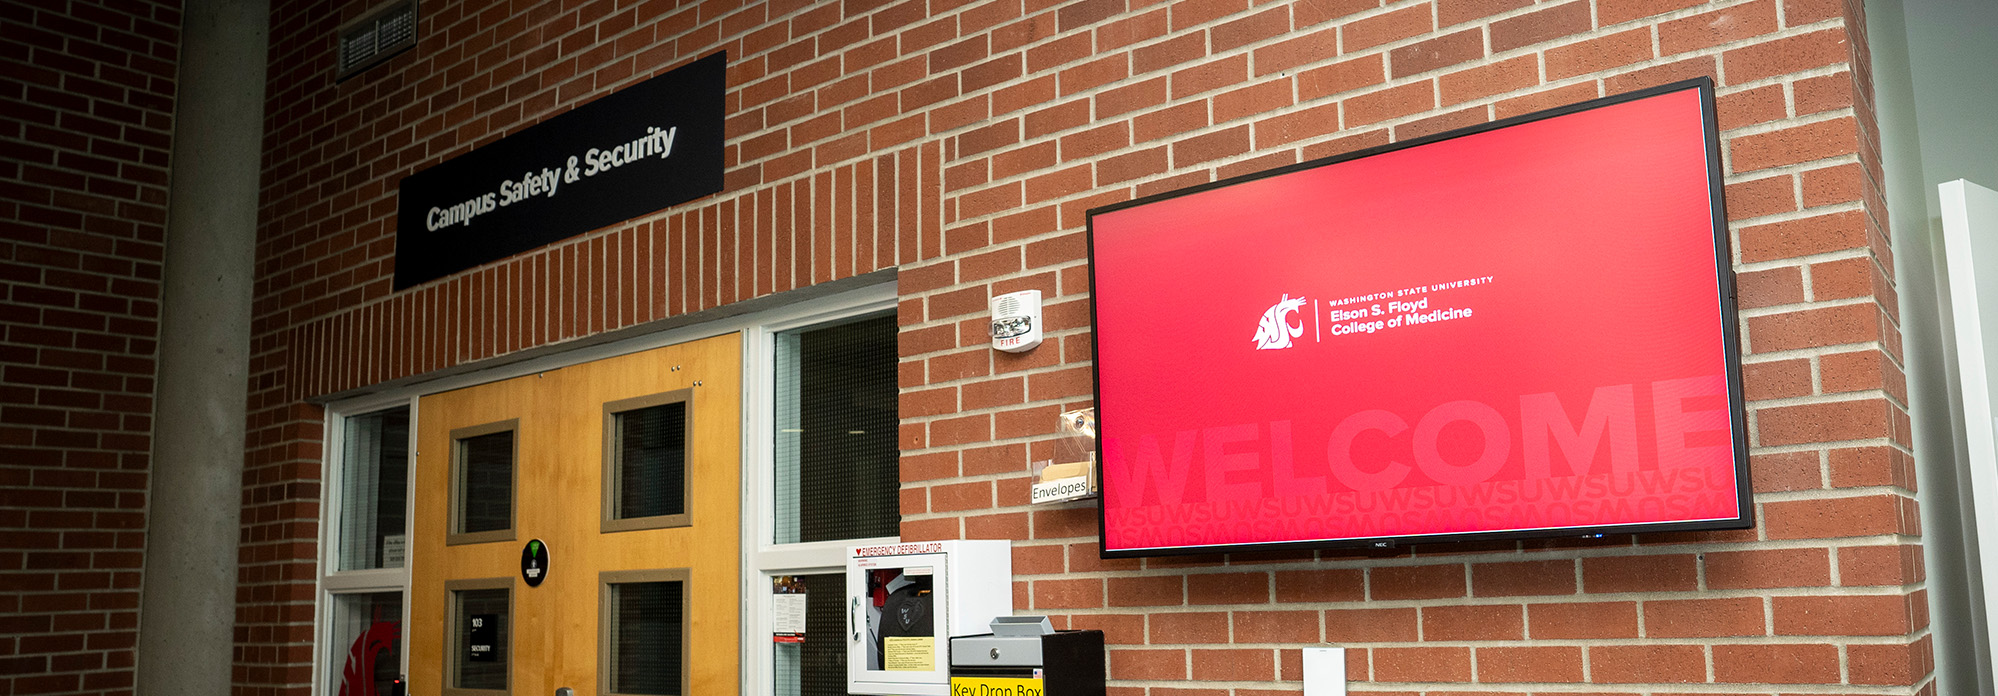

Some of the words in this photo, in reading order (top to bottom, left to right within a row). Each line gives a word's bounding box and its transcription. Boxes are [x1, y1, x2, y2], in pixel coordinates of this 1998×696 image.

[426, 192, 496, 232] Campus
[499, 167, 561, 206] Safety
[564, 155, 580, 183] &
[584, 126, 677, 177] Security
[1329, 291, 1394, 307] WASHINGTON
[1397, 285, 1428, 297] STATE
[1431, 275, 1494, 292] UNIVERSITY
[1330, 308, 1368, 322] Elson
[1371, 304, 1385, 316] S.
[1388, 297, 1428, 314] Floyd
[1331, 319, 1384, 336] College
[1387, 316, 1403, 328] of
[1406, 306, 1473, 325] Medicine
[1002, 336, 1021, 347] FIRE
[1103, 373, 1728, 508] WELCOME
[1033, 481, 1087, 500] Envelopes
[862, 546, 896, 558] EMERGENCY
[897, 543, 942, 556] DEFIBRILLATOR
[472, 617, 483, 628] 103
[954, 683, 976, 696] Key
[980, 684, 1012, 696] Drop
[1017, 684, 1042, 696] Box
